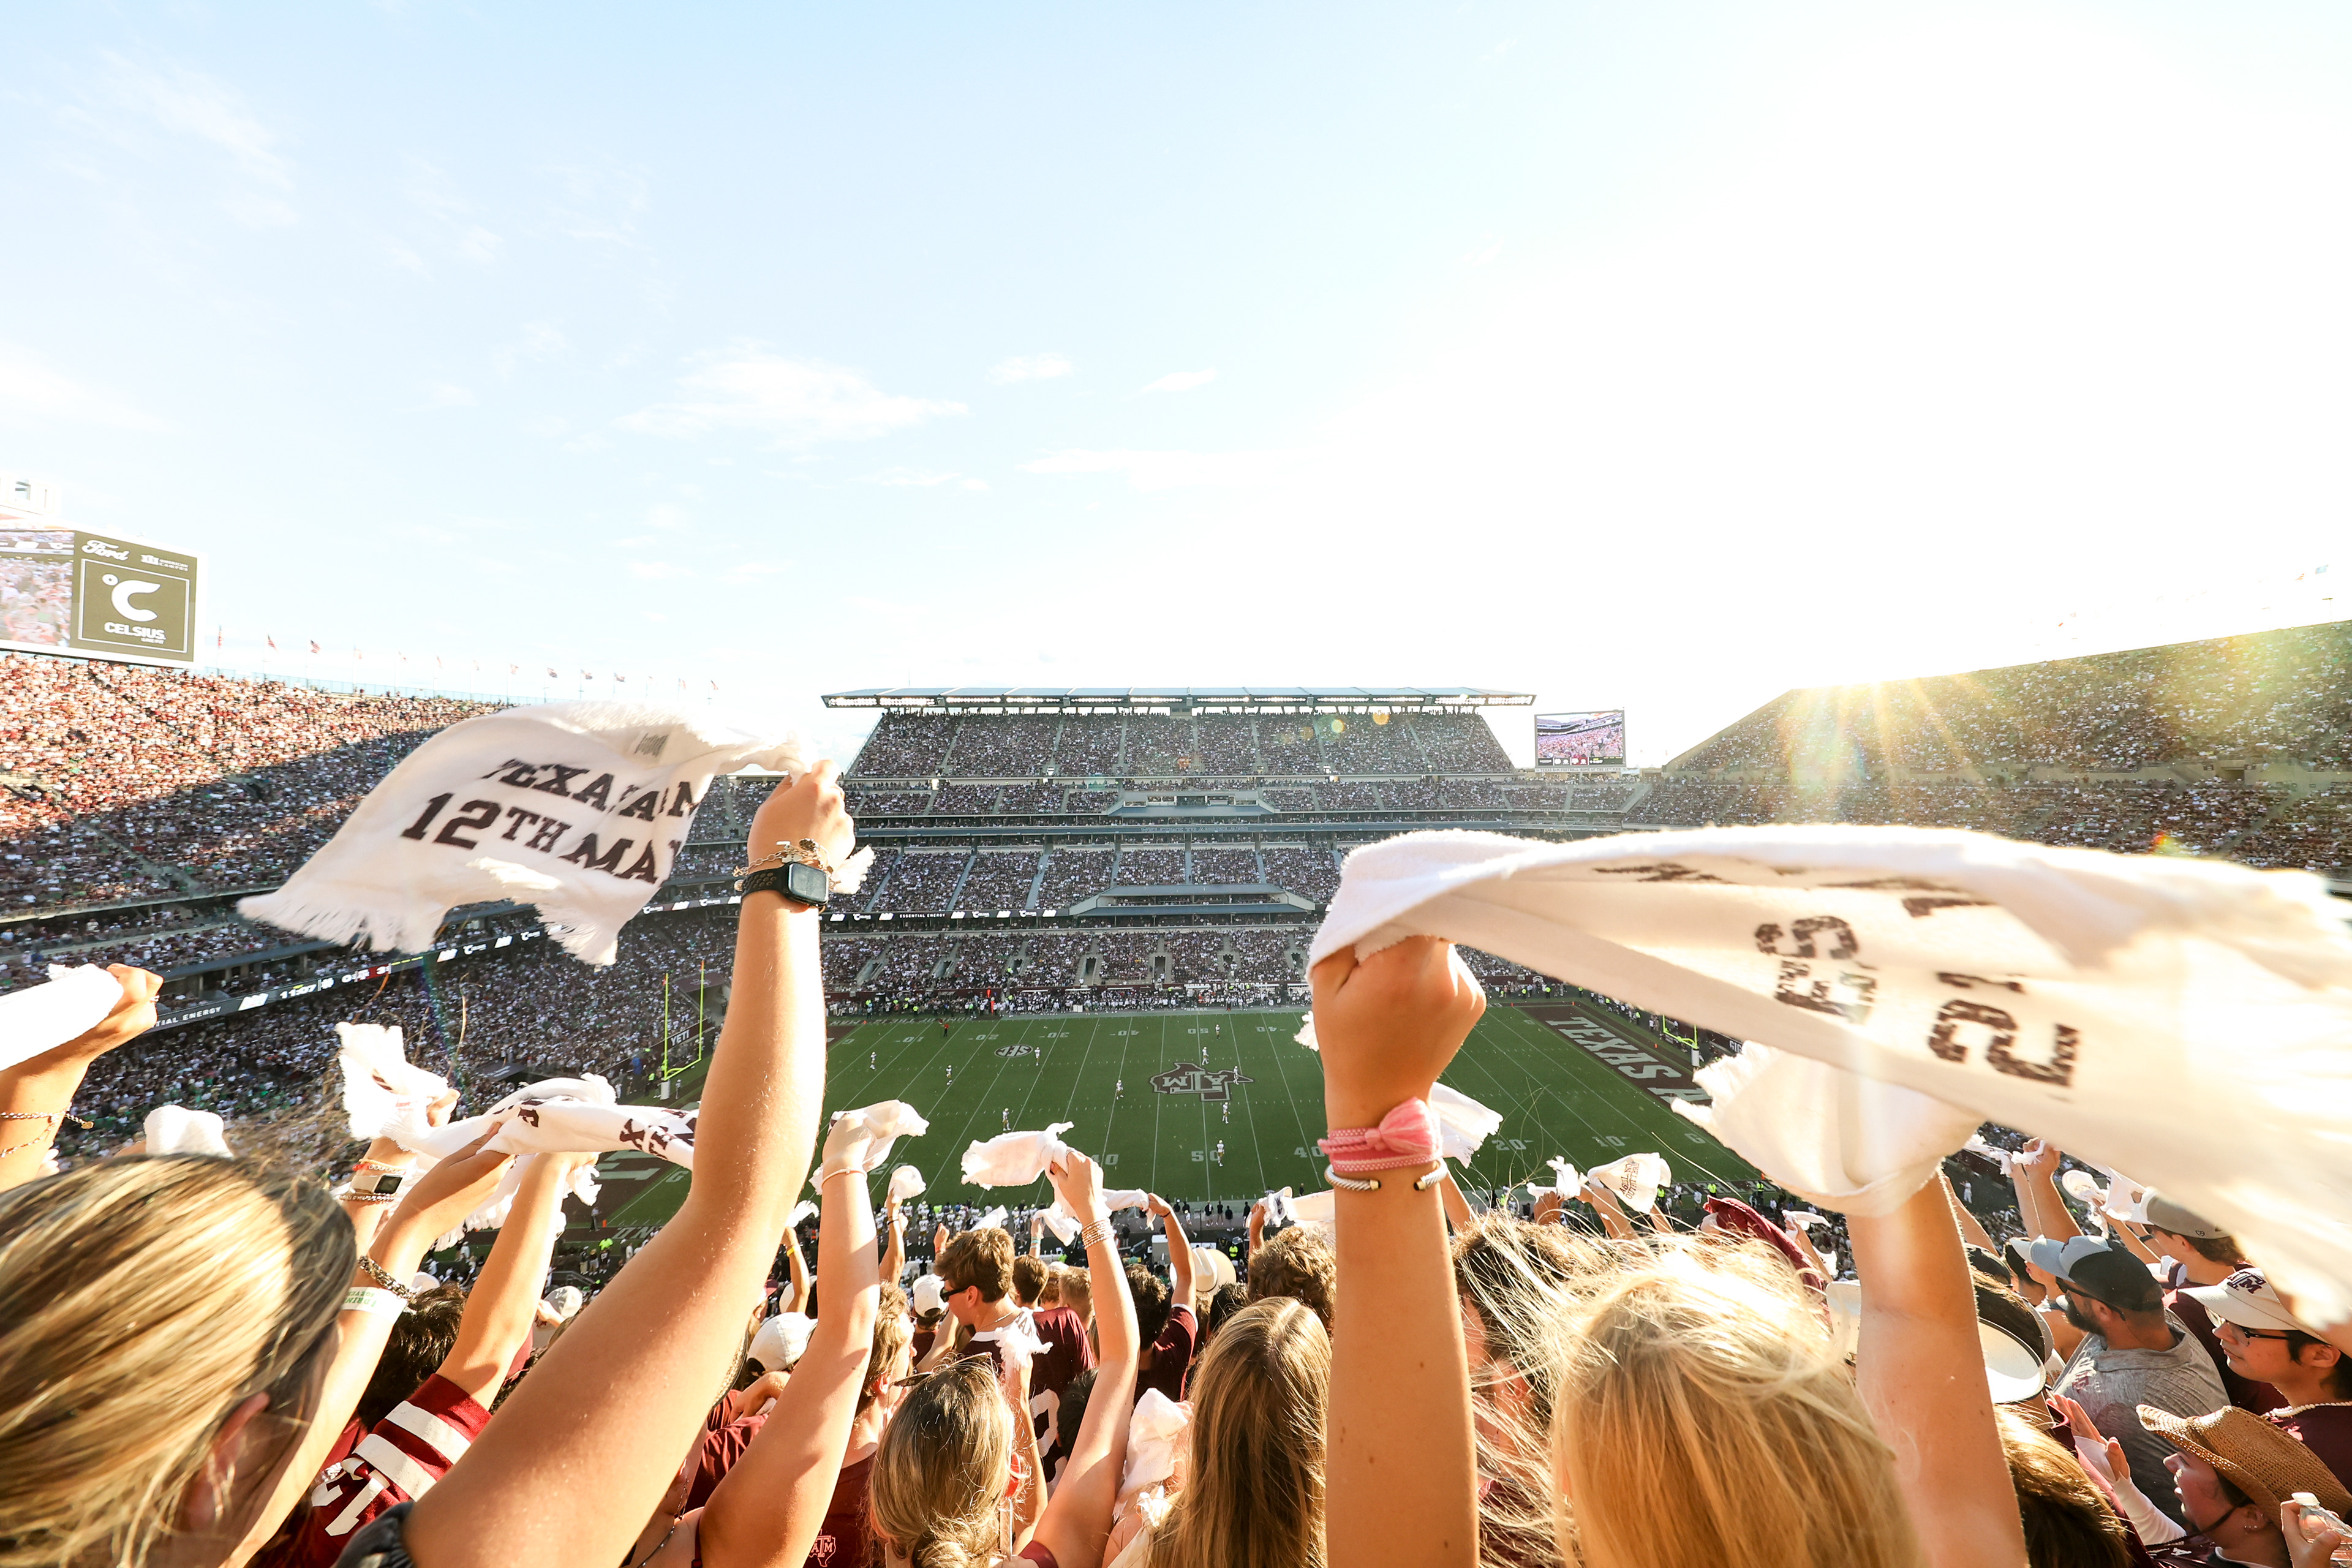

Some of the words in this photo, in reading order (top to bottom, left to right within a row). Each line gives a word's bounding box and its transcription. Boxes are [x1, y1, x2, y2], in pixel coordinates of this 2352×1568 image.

[81, 540, 130, 560] Ford
[104, 622, 166, 639] CELSIUS
[401, 793, 573, 853] 12TH
[183, 1006, 222, 1021] ENERGY
[671, 1030, 690, 1046] YETI
[998, 1045, 1030, 1057] SEC
[1545, 1017, 1682, 1079] TEXAS
[1493, 1139, 1526, 1151] 20
